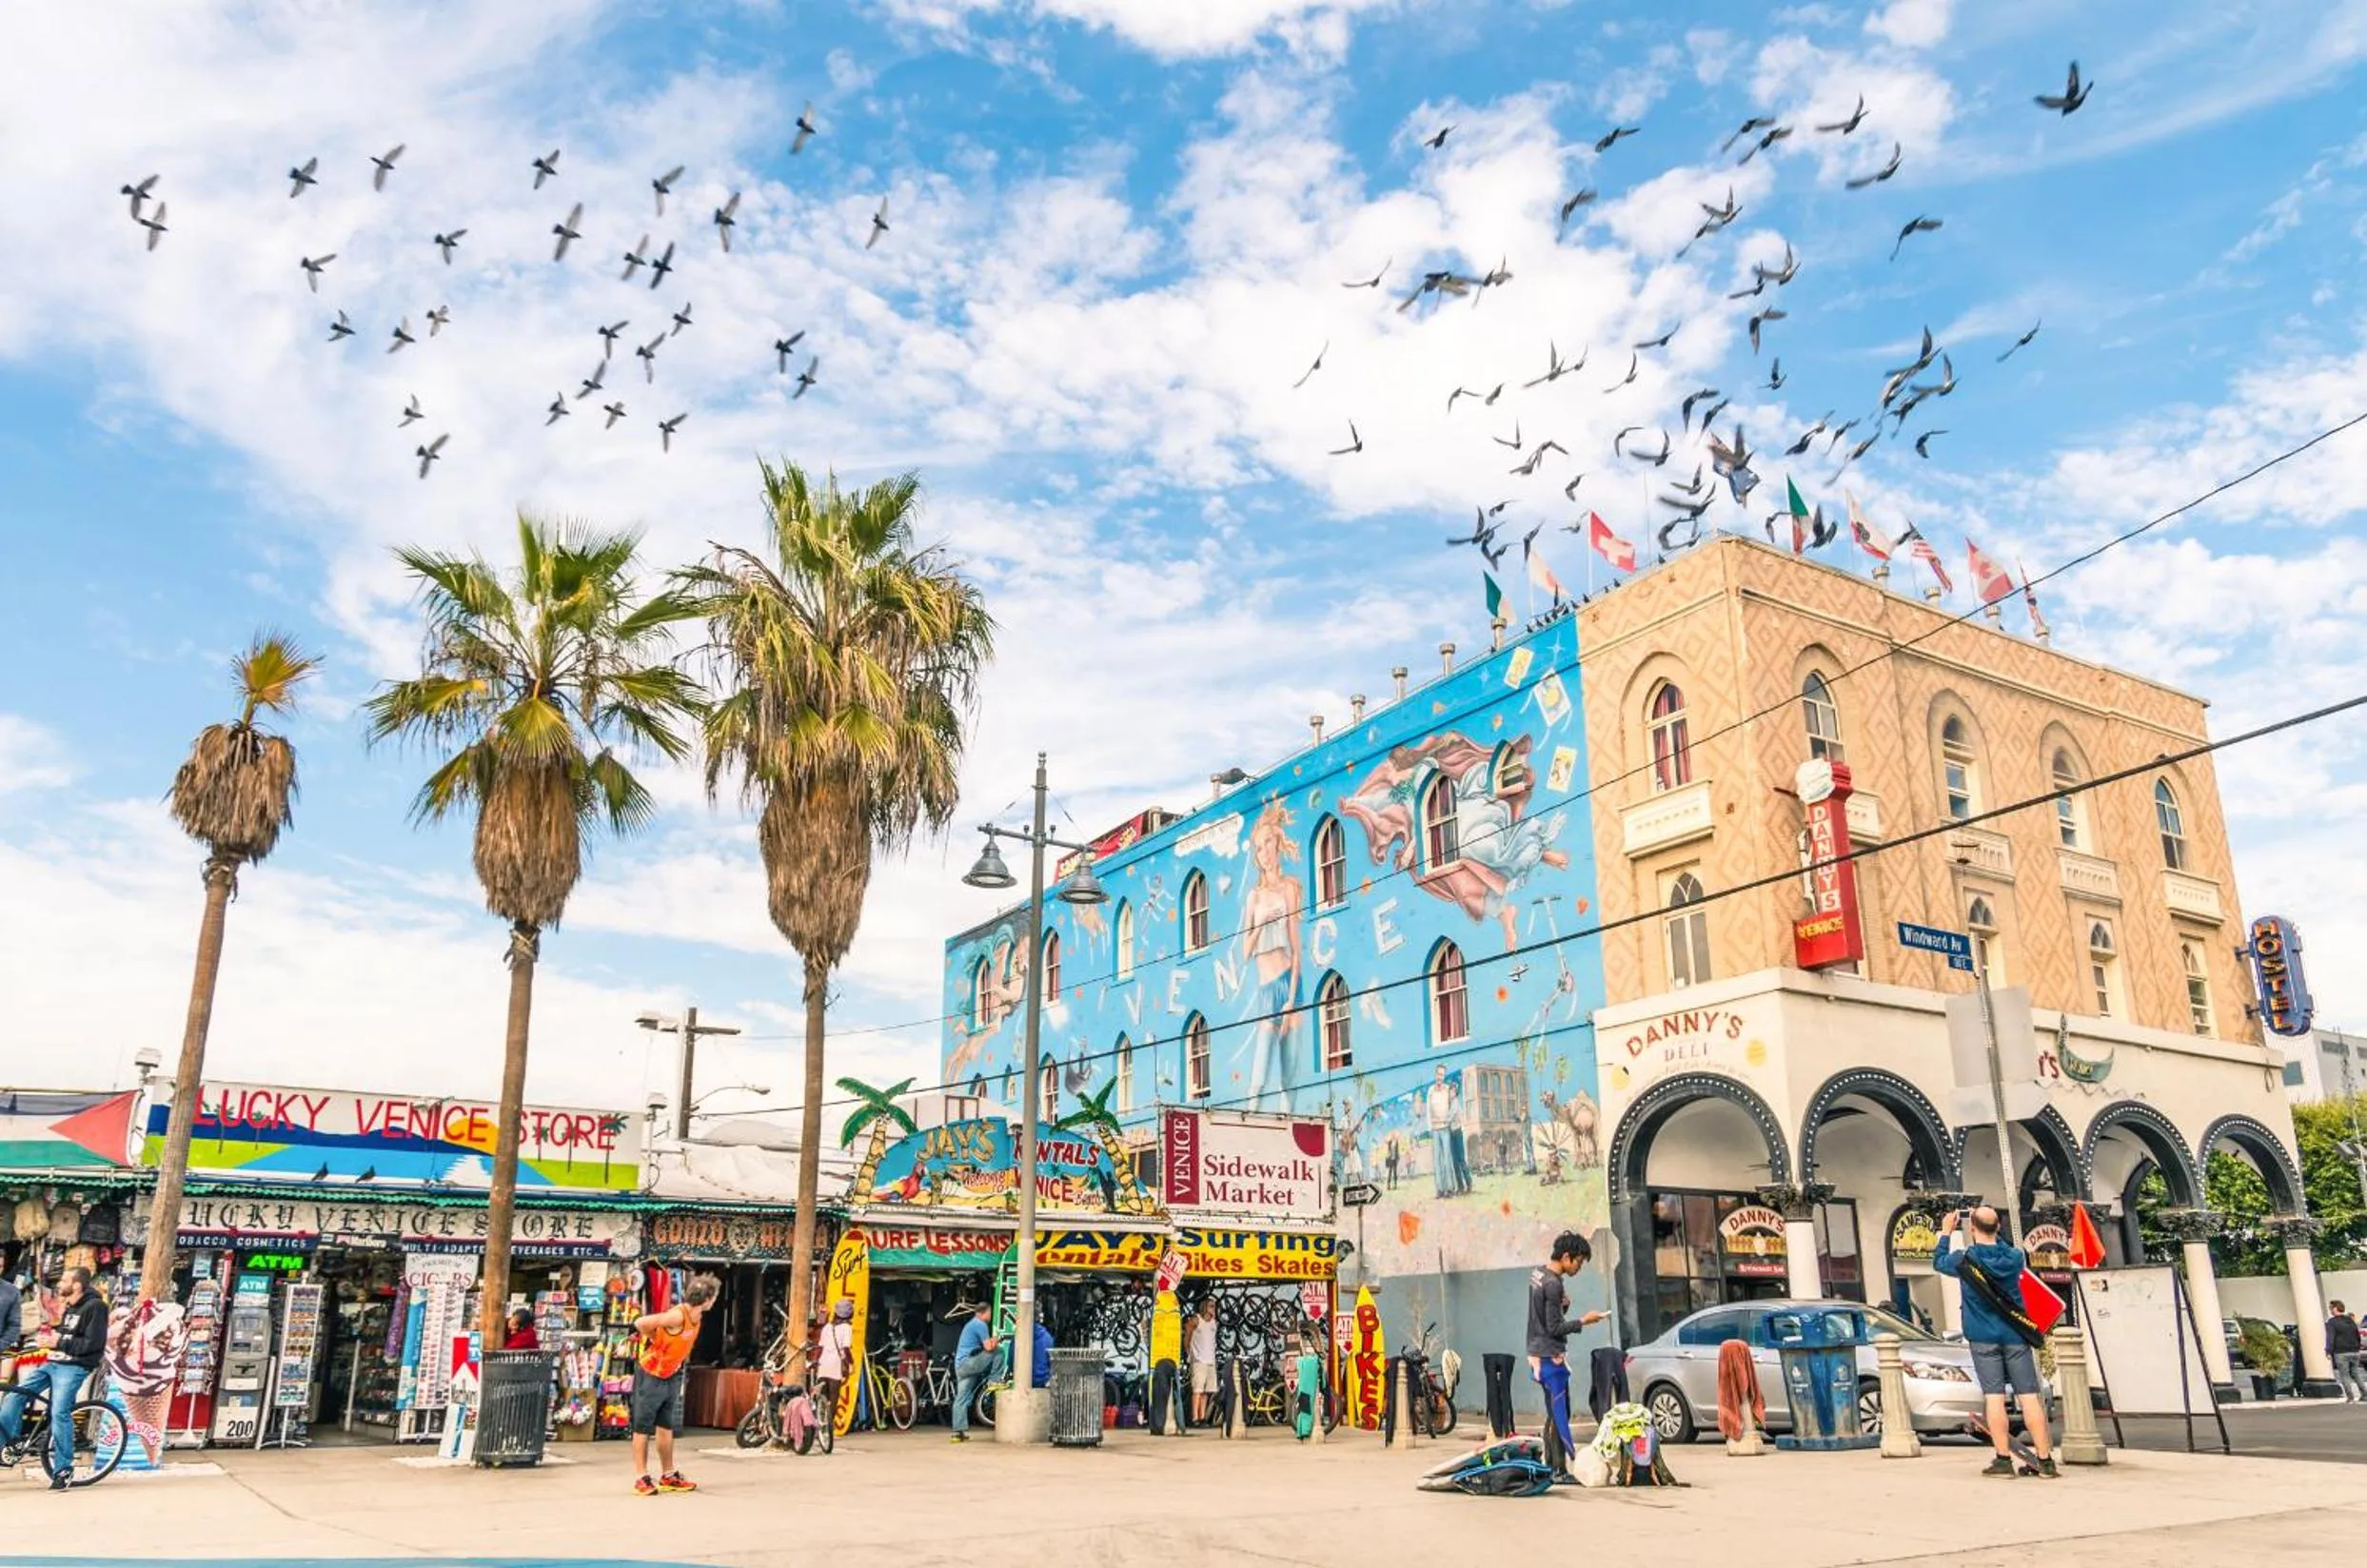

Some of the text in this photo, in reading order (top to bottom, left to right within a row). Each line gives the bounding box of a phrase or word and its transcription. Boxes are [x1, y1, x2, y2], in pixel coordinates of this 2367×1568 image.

[1903, 925, 1948, 951] Windward
[2255, 919, 2294, 1030] HOSTEL
[1627, 1011, 1743, 1058] DANNY'S
[191, 1085, 330, 1132] LUCKY
[355, 1098, 488, 1143] VENICE
[1173, 1116, 1192, 1197] VENICE
[1203, 1154, 1314, 1182] Sidewalk
[1205, 1180, 1294, 1206] Market
[188, 1201, 594, 1239] UCKY VENICE SORE
[1728, 1209, 1785, 1231] DANNY'S
[178, 1236, 306, 1249] OBACCO COSMETICS
[510, 1246, 564, 1256] EVERAGES
[923, 1226, 1012, 1255] LESSONS
[1178, 1226, 1334, 1257] Surfing
[247, 1254, 304, 1269] ATM
[832, 1243, 867, 1280] Surf
[1036, 1247, 1160, 1266] entals
[1258, 1253, 1333, 1275] Skates
[239, 1278, 267, 1291] ATM
[1304, 1281, 1327, 1297] ATM
[1355, 1304, 1380, 1431] BIKES
[227, 1421, 254, 1438] 200
